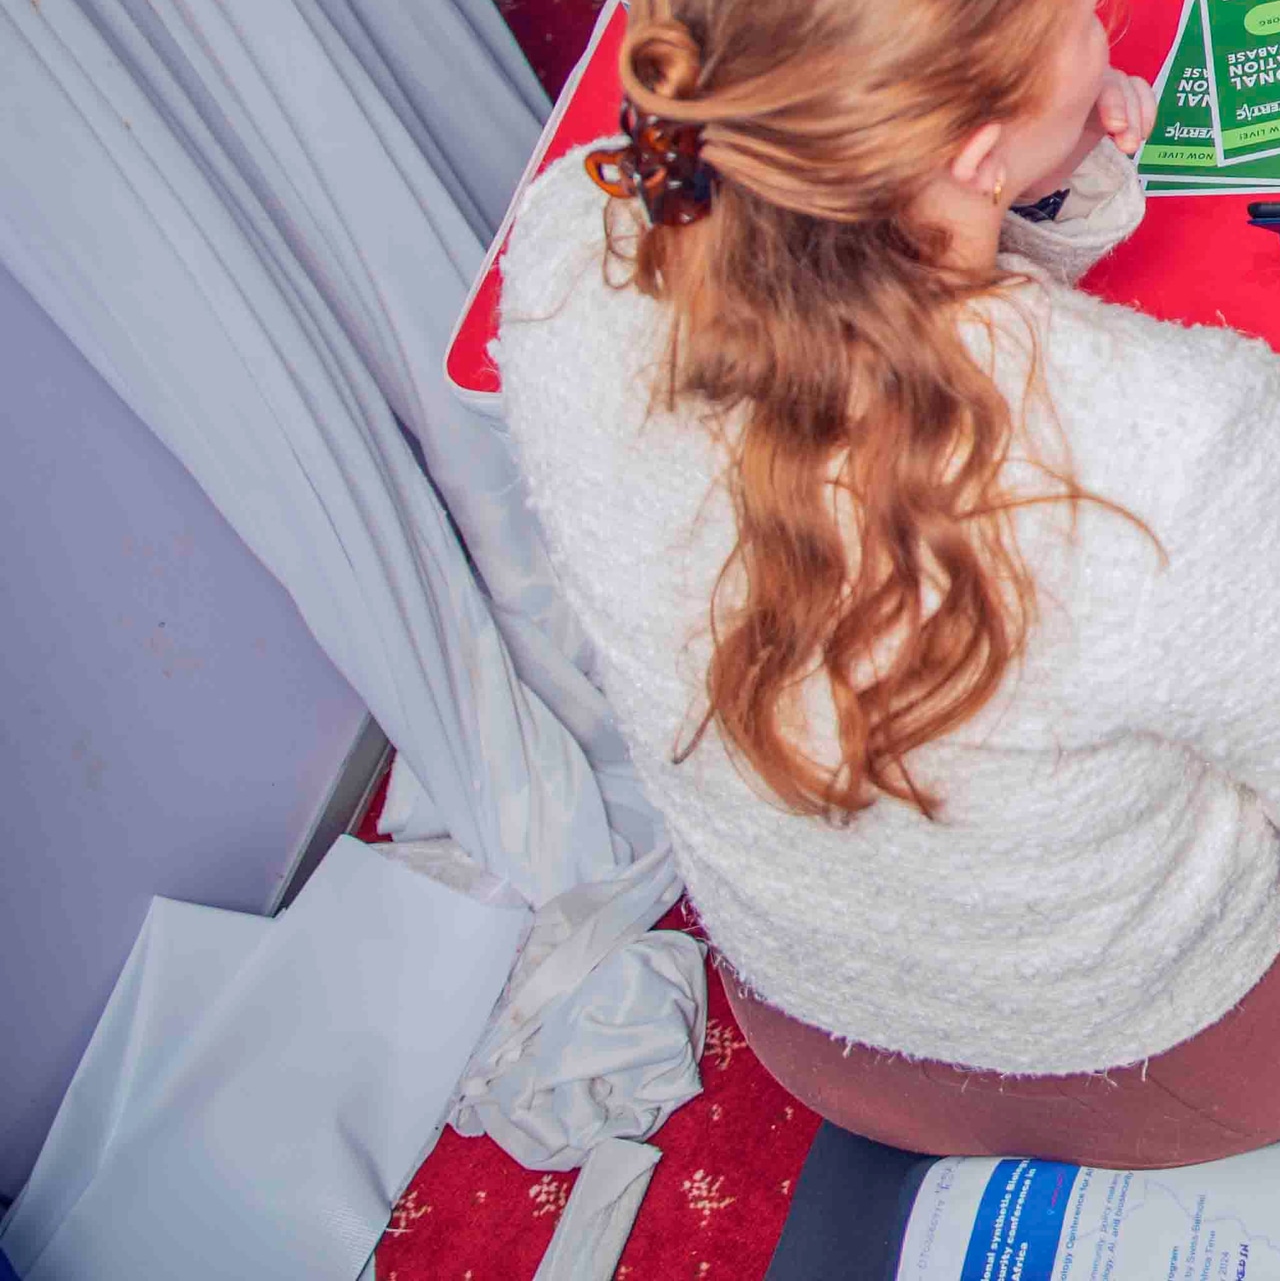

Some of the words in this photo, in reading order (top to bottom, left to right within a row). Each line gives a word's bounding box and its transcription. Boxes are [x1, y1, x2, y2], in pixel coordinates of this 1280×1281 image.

[1238, 127, 1265, 140] LIVE!
[1157, 151, 1185, 161] LIVE!
[1188, 152, 1214, 161] NOW
[990, 1193, 1012, 1251] synthetic
[1006, 1178, 1033, 1245] conference
[1065, 1192, 1085, 1250] Conference
